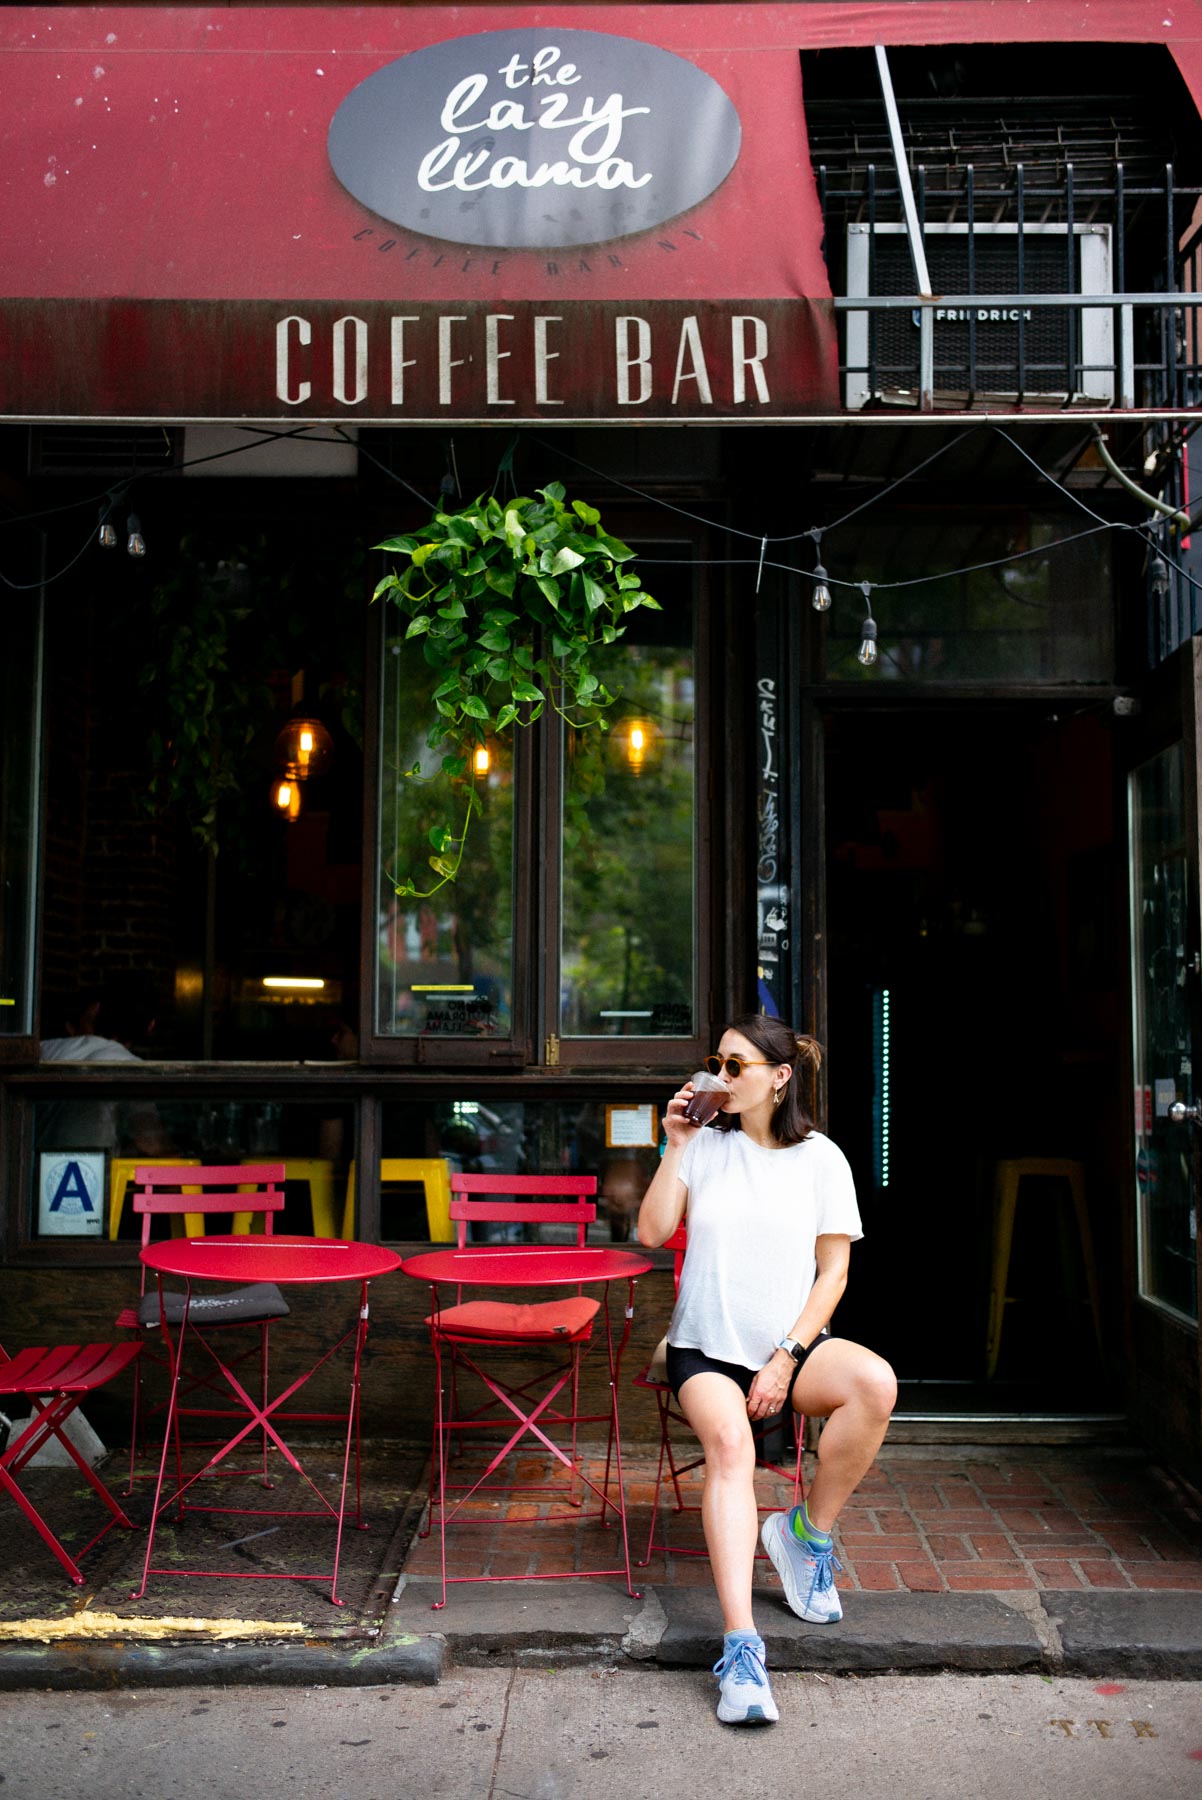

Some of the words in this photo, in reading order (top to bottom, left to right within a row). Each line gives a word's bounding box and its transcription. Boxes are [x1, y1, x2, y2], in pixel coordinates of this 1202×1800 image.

[498, 46, 581, 89] the
[440, 74, 650, 164] lazy
[417, 137, 652, 192] llama
[352, 228, 502, 276] COFFEE
[546, 254, 624, 277] BAR
[657, 229, 703, 254] NY
[936, 309, 1031, 321] FRIDRICH
[276, 314, 563, 406] COFFEE
[616, 314, 770, 407] BAR
[49, 1161, 94, 1212] A
